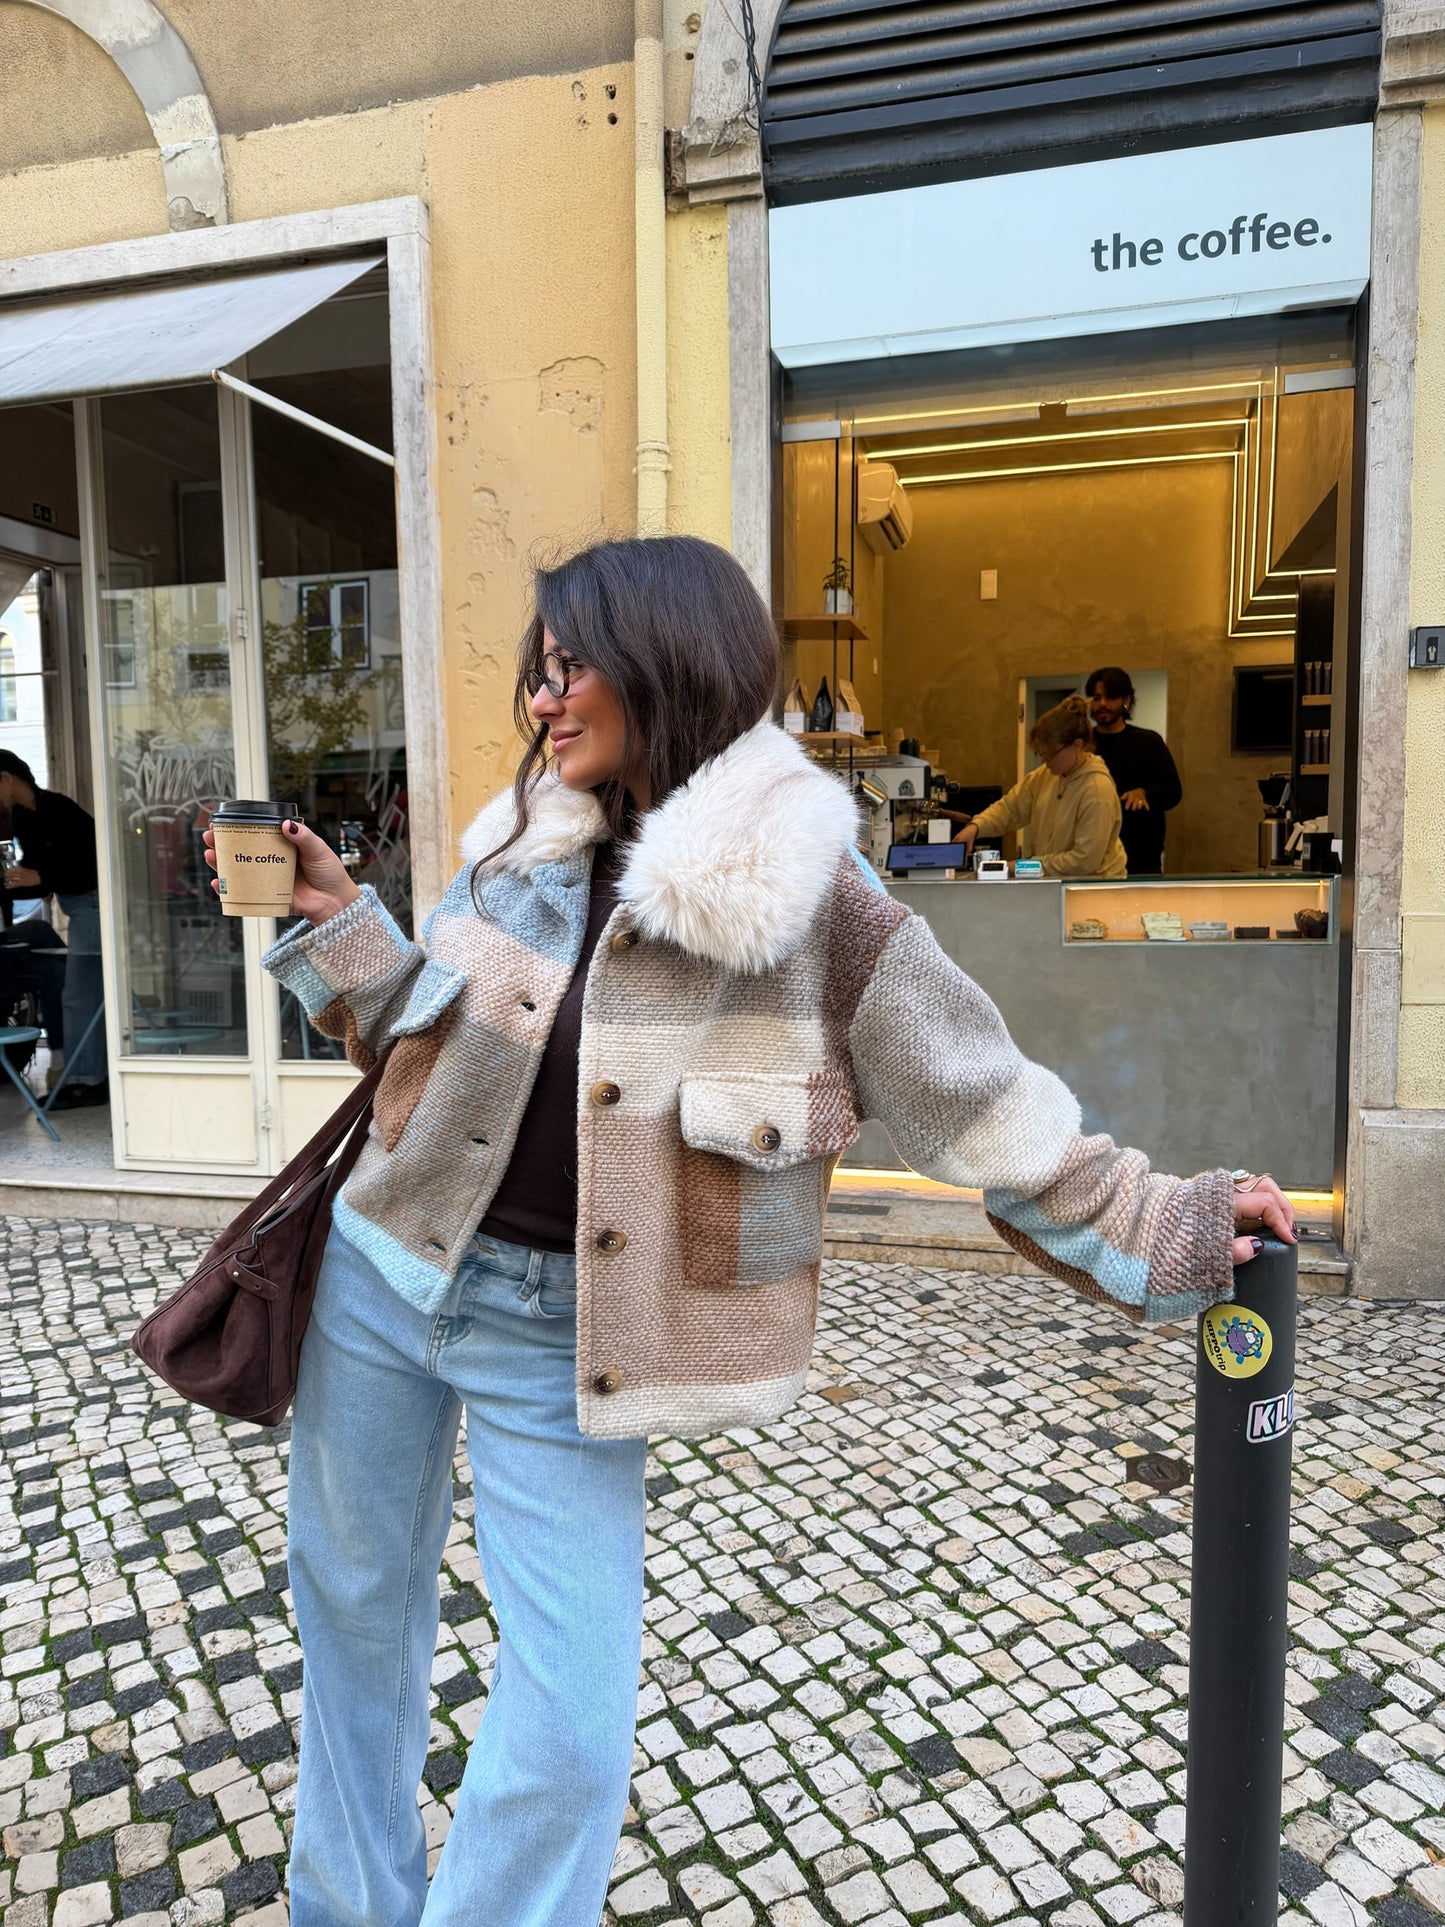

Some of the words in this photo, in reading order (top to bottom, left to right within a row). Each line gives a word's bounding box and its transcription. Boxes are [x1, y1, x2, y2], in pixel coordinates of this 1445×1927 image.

[1091, 232, 1164, 272] the
[1177, 212, 1332, 261] coffee.
[235, 853, 253, 863] the
[255, 853, 288, 864] coffee.
[1206, 1319, 1226, 1371] HIPPOtrip
